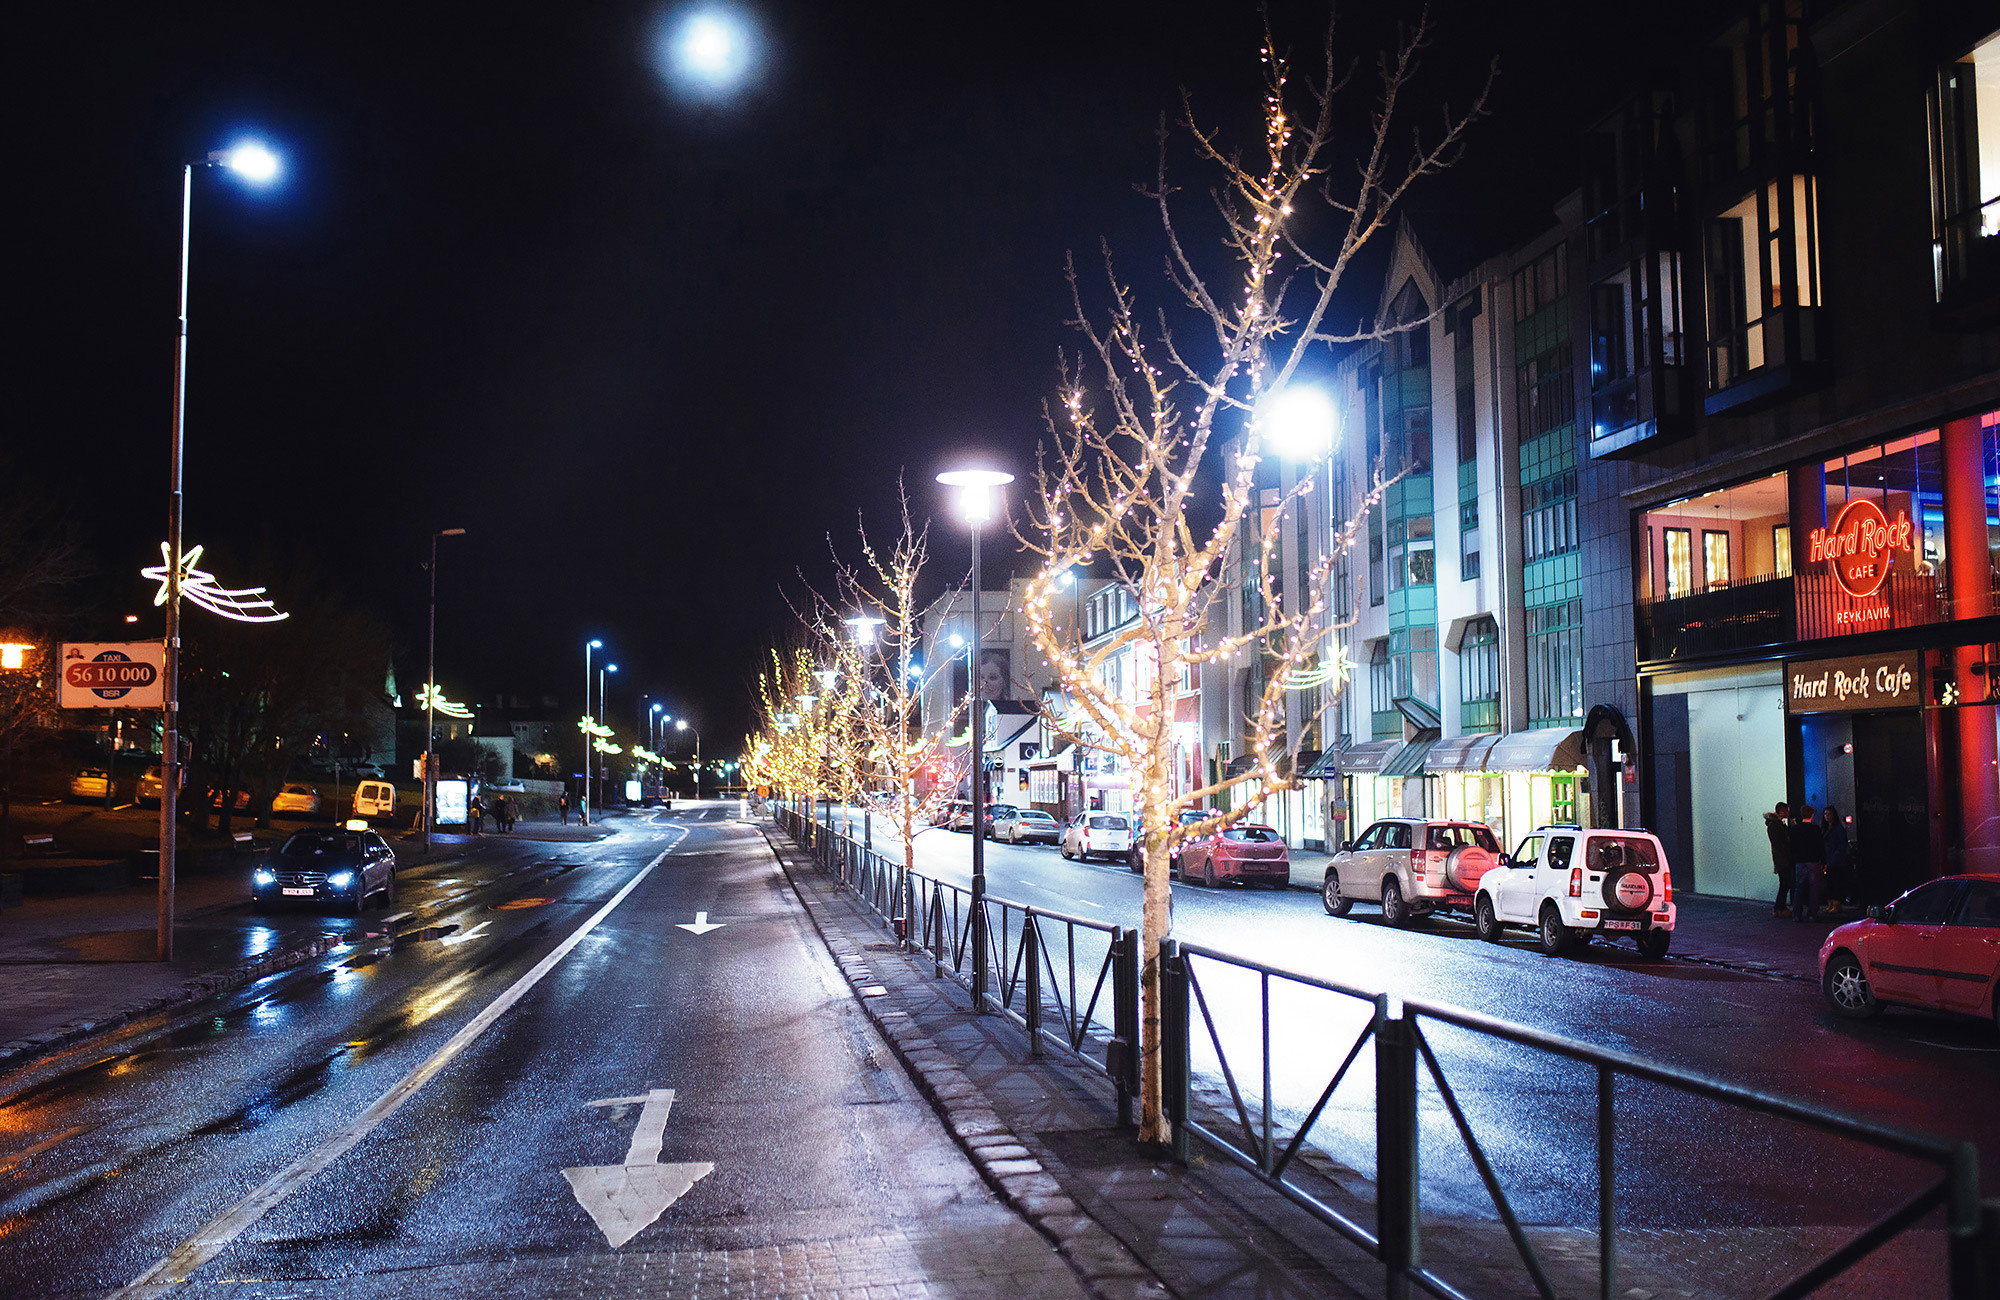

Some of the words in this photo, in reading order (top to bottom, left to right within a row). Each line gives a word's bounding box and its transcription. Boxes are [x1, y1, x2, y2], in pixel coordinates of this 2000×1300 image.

[1810, 520, 1859, 562] Hard
[1861, 510, 1911, 558] Rock
[1848, 564, 1874, 580] CAFE
[1836, 606, 1891, 624] REYKJAVIK
[103, 654, 121, 662] TAXI
[72, 667, 92, 682] 56
[97, 668, 117, 682] 10
[120, 667, 150, 682] 000
[1793, 671, 1829, 699] Hard
[1833, 667, 1870, 701] Rock
[1875, 663, 1912, 698] Cafe
